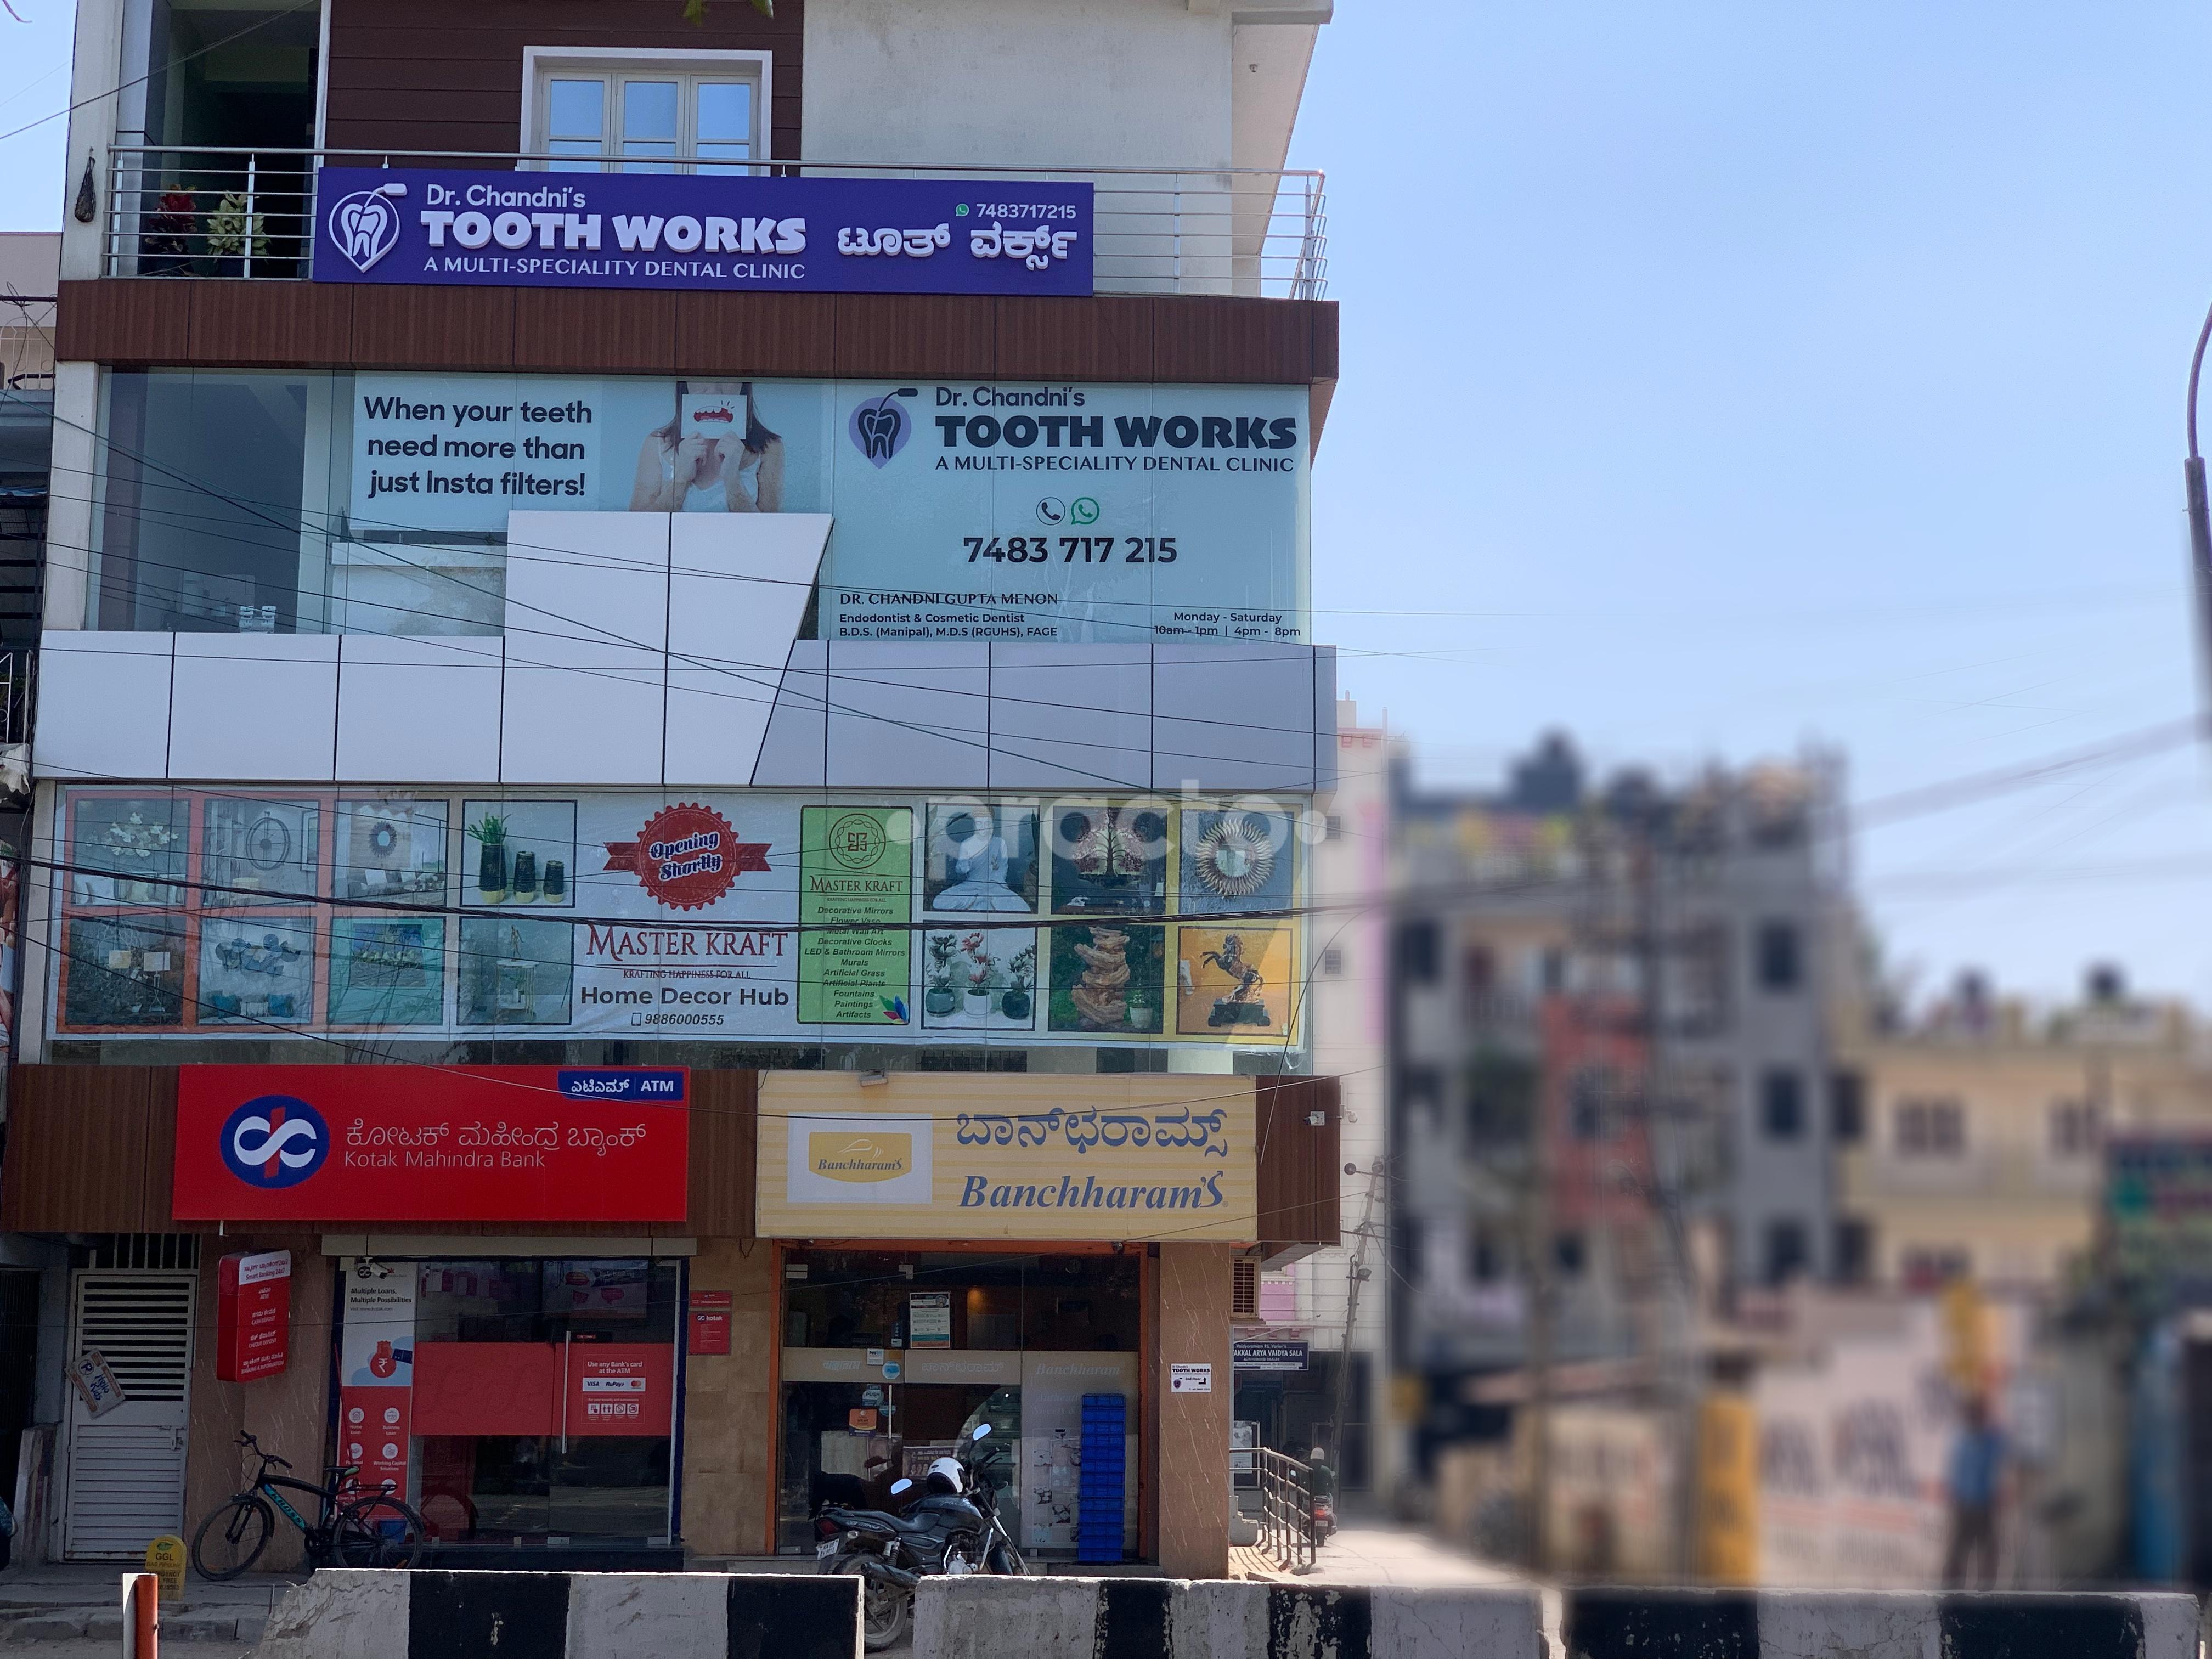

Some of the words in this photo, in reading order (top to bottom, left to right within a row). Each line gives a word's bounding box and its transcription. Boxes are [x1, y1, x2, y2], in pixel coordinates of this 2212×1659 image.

[427, 183, 461, 206] Dr.
[466, 185, 586, 207] Chandni's
[977, 204, 1076, 219] 7483717215
[421, 211, 601, 250] TOOTH
[612, 214, 806, 256] WORKS
[838, 223, 951, 257] ಟೂತ್
[424, 257, 438, 272] A
[445, 257, 639, 275] MULTI-SPECIALITY
[645, 261, 726, 278] DENTAL
[733, 263, 805, 279] CLINIC
[936, 386, 968, 407] Dr.
[973, 386, 1085, 407] Chandni's
[364, 396, 445, 420] When
[452, 404, 513, 427] your
[521, 401, 592, 424] teeth
[935, 415, 1103, 448] TOOTH
[1114, 415, 1297, 450] WORKS
[368, 434, 437, 456] need
[444, 439, 515, 459] more
[523, 436, 585, 460] than
[935, 456, 949, 470] A
[955, 456, 1137, 471] MULTI-SPECIALITY
[1144, 456, 1220, 472] DENTAL
[1226, 457, 1294, 472] CLINIC
[368, 470, 419, 499] just
[427, 471, 493, 495] Insta
[500, 472, 585, 496] filters!
[963, 537, 1048, 563] 7483
[1059, 537, 1114, 563] 717
[1125, 538, 1177, 563] 215
[840, 593, 865, 605] DR.
[868, 593, 940, 605] CHANDNI
[944, 593, 996, 605] GUPTA
[1001, 593, 1058, 605] MENON
[840, 613, 911, 623] Endodontist
[913, 614, 922, 623] &
[925, 613, 979, 623] Cosmetic
[983, 613, 1025, 623] Dentist
[1173, 612, 1220, 623] Monday
[1231, 613, 1282, 624] Saturday
[840, 627, 873, 636] B.D.S.
[876, 627, 933, 639] (Manipal),
[936, 627, 968, 636] M.D.S
[972, 627, 1024, 638] (RGUHS),
[1027, 627, 1058, 636] FAGE
[1154, 625, 1184, 635] 10am
[1195, 626, 1218, 637] 1pm
[1234, 627, 1260, 638] 4pm
[1274, 627, 1301, 638] 8pm
[649, 832, 720, 860] Opening
[659, 854, 722, 881] Shortly
[809, 875, 861, 893] MASTER
[865, 881, 903, 891] KRAFT
[586, 923, 698, 961] MASTER
[706, 933, 788, 956] KRAFT
[623, 970, 667, 978] KRAFTING
[716, 970, 733, 979] FOR
[736, 971, 751, 979] ALL
[582, 987, 652, 1004] Home
[661, 988, 732, 1005] Decor
[740, 988, 788, 1005] Hub
[645, 1013, 724, 1025] 9886000555
[641, 1080, 674, 1092] ATM
[346, 1118, 449, 1146] ಕೋಟಕ್
[568, 1124, 646, 1155] ಬ್ಯಾಂಕ್
[345, 1150, 397, 1167] Kotak
[406, 1150, 493, 1167] Mahindra
[501, 1150, 545, 1167] Bank
[90, 1383, 103, 1401] Kids
[94, 1373, 109, 1393] Hello
[156, 1552, 174, 1561] GGL
